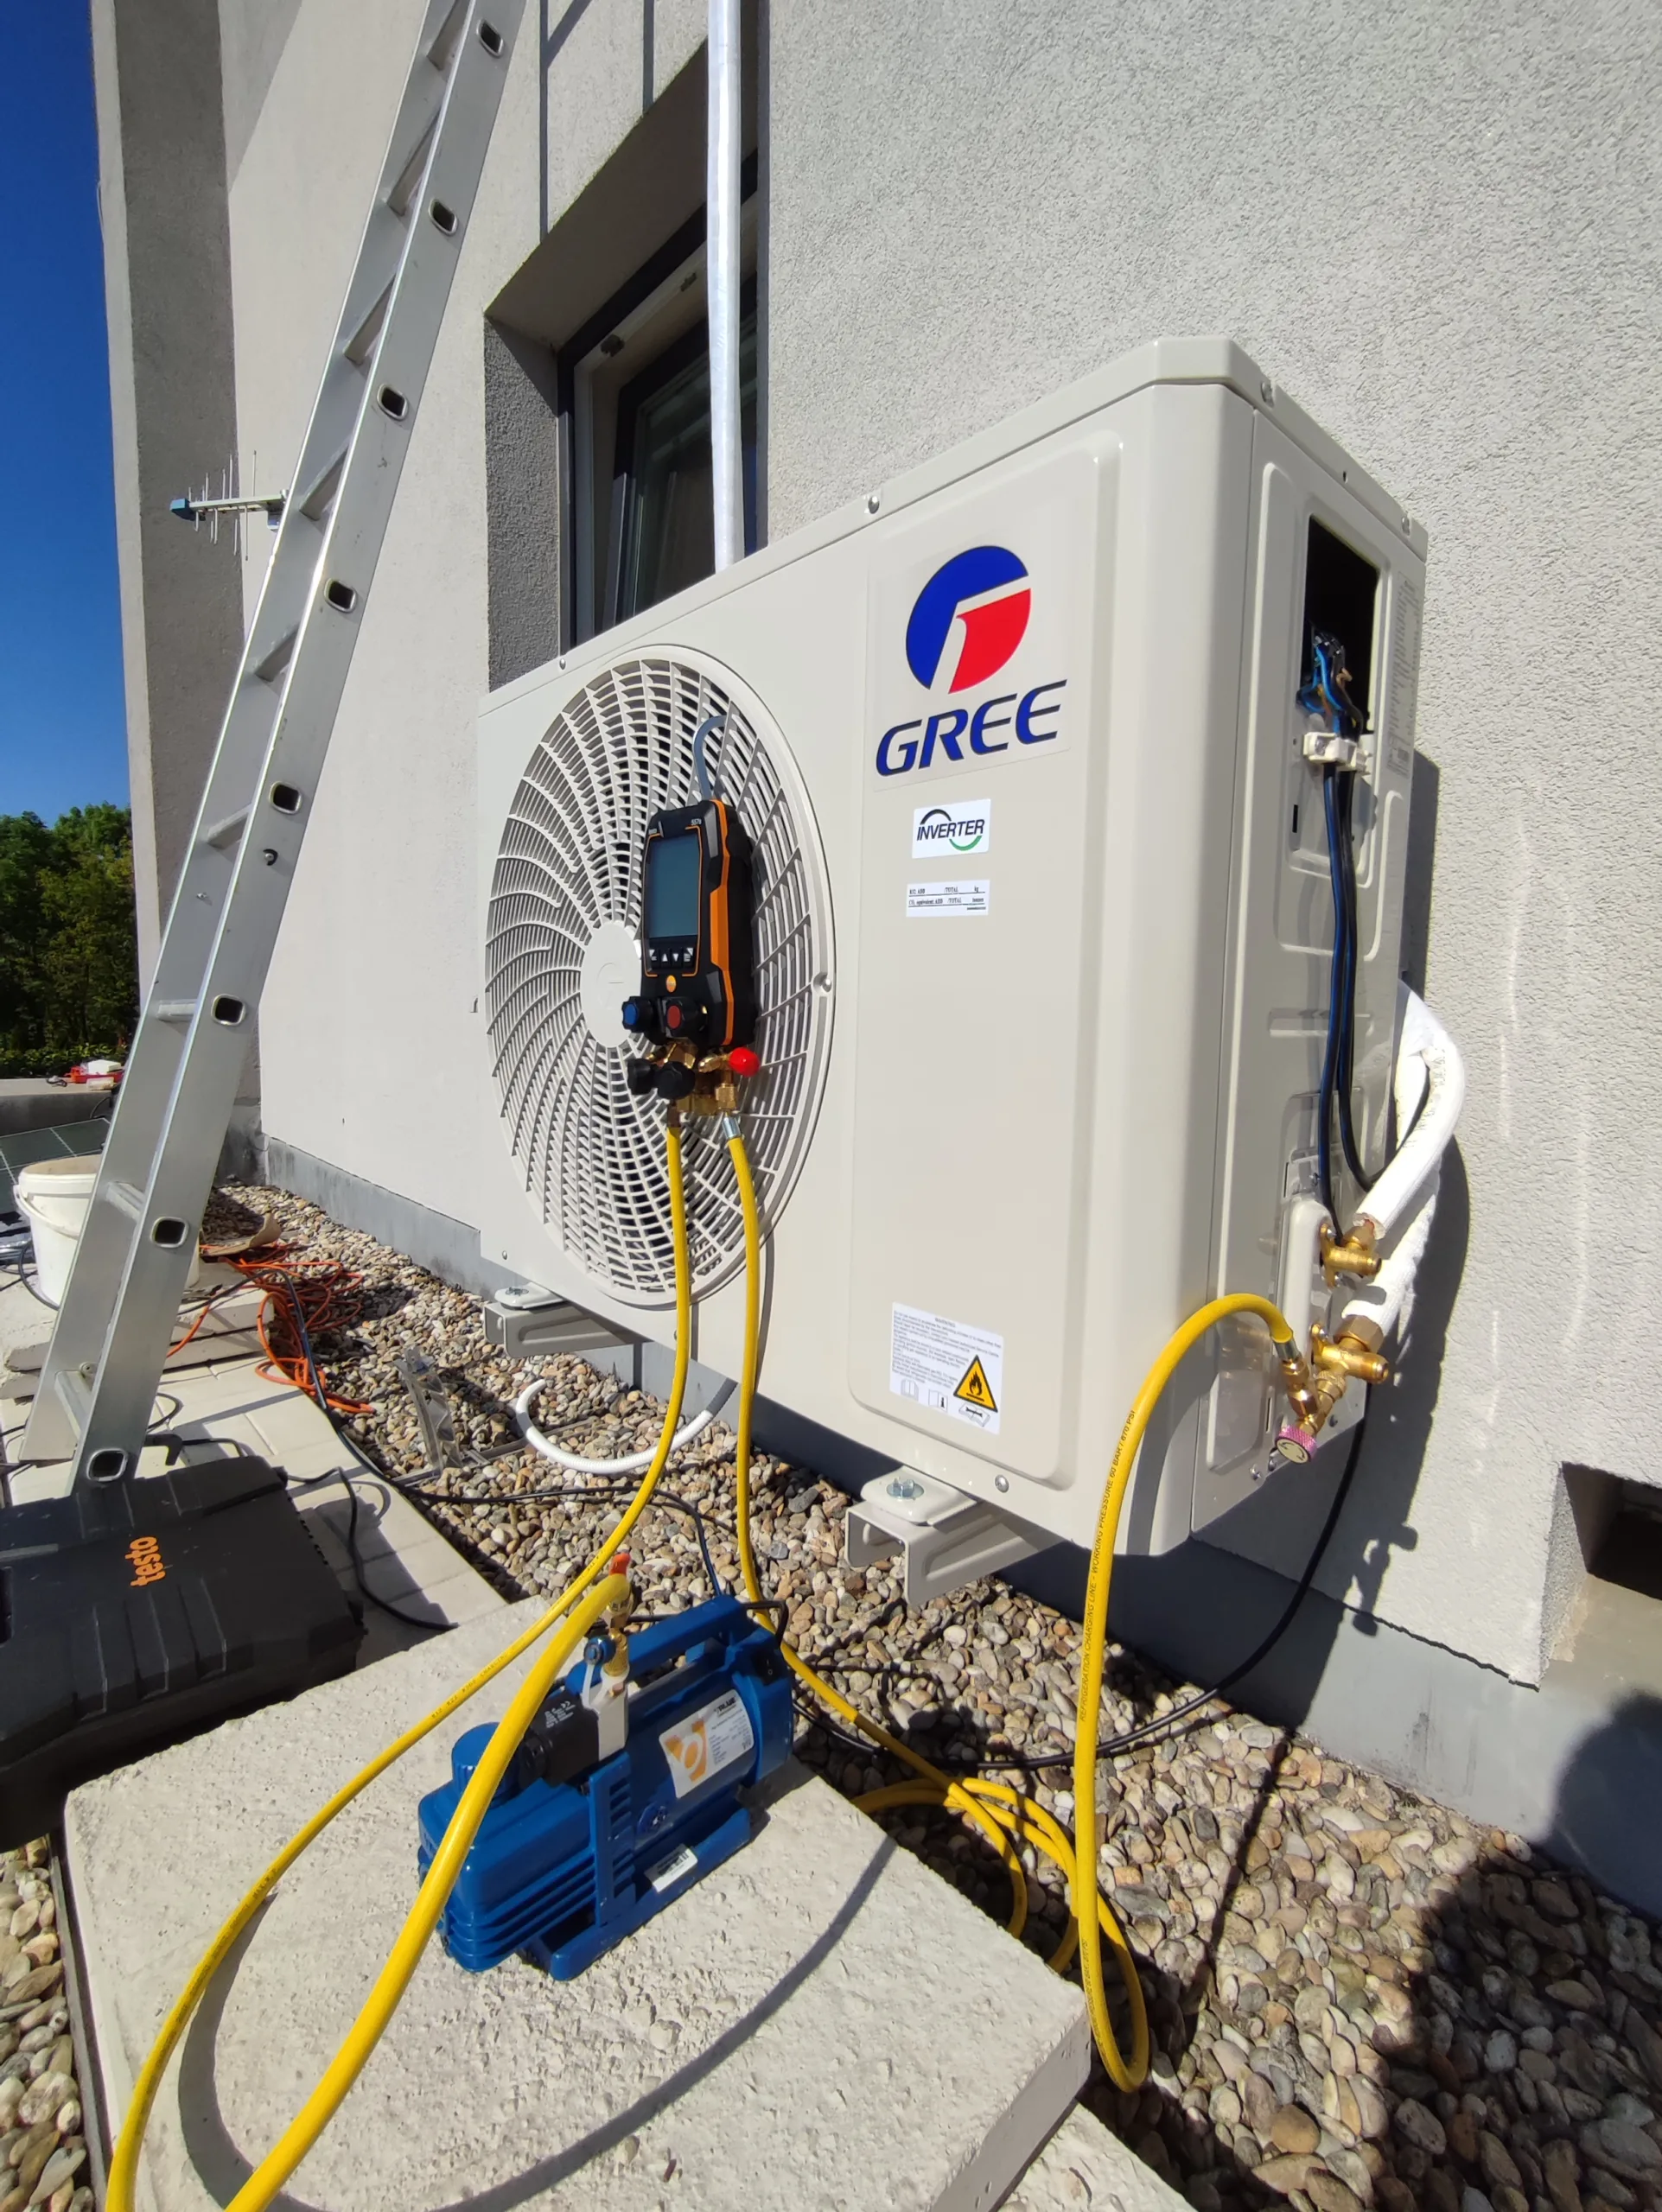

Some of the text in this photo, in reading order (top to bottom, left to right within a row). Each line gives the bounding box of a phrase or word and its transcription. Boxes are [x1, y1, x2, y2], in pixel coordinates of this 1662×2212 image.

[876, 679, 1067, 778] GREE
[916, 818, 985, 842] INVERTER
[1126, 1410, 1136, 1425] PSI
[1109, 1467, 1117, 1478] 60
[1112, 1446, 1123, 1466] BAR
[1098, 1478, 1114, 1529] PRESSURE
[124, 1536, 165, 1586] testo
[1091, 1531, 1104, 1573] WORKING
[1088, 1583, 1097, 1604] LINE
[1084, 1604, 1095, 1651] CHARGING
